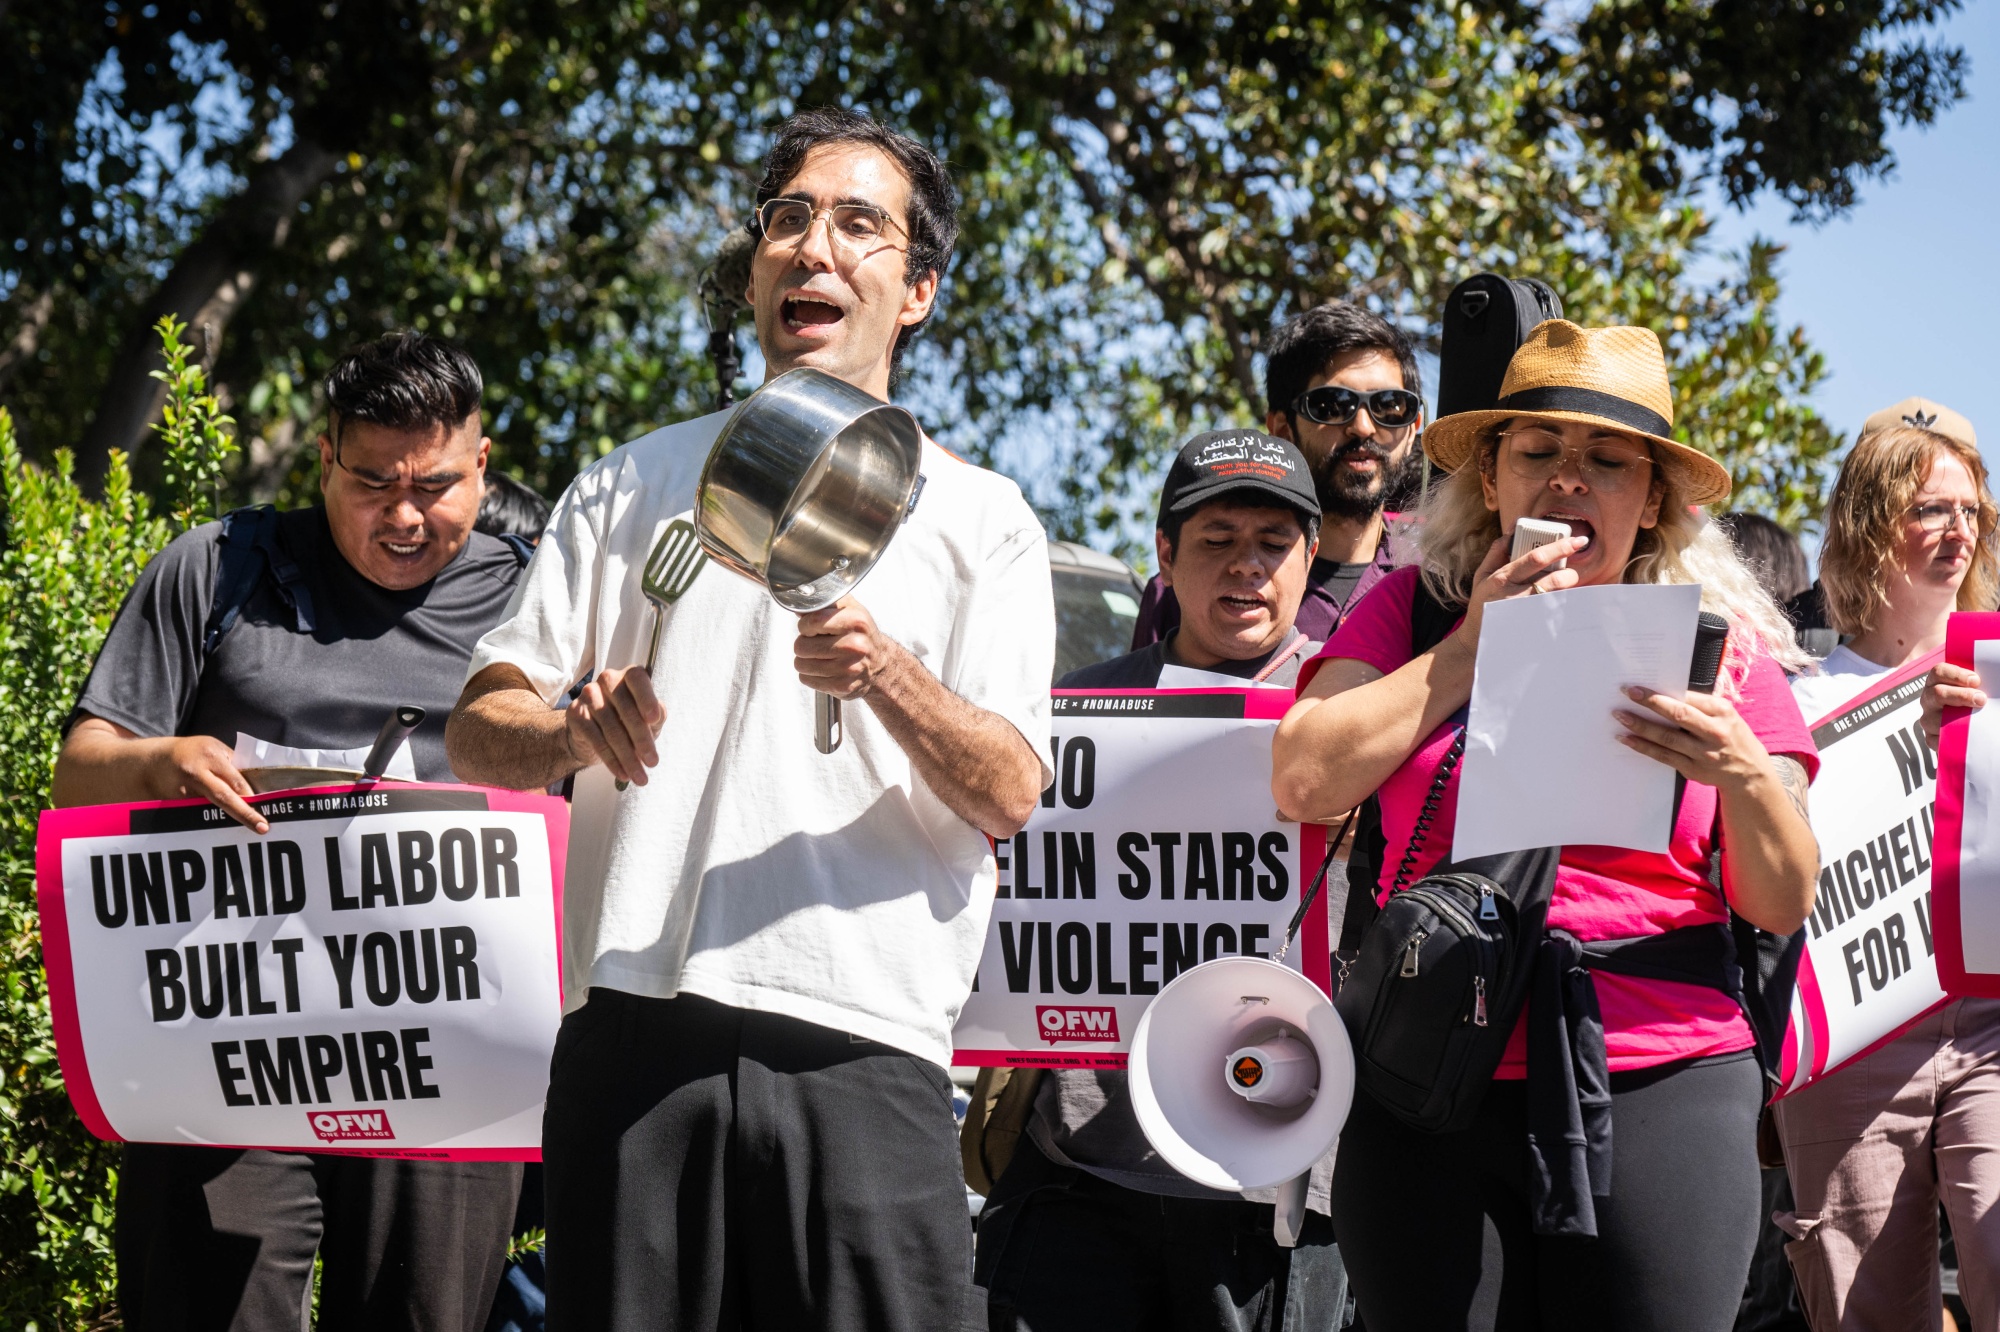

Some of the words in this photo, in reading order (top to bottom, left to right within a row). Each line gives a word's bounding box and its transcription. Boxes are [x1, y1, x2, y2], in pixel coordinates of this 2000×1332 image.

[1255, 469, 1282, 480] clothing
[1082, 698, 1155, 710] #NOMAABUSE
[1833, 716, 1852, 733] ONE
[1851, 706, 1873, 723] FAIR
[1870, 695, 1893, 713] WAGE
[203, 808, 226, 821] ONE
[260, 801, 294, 816] WAGE
[309, 794, 389, 812] #NOMAABUSE
[90, 838, 307, 929] UNPAID
[324, 827, 521, 912] LABOR
[1116, 831, 1290, 902] STARS
[144, 937, 305, 1023] BUILT
[322, 925, 482, 1010] YOUR
[1842, 912, 1912, 1007] FOR
[1041, 1009, 1111, 1031] OFW
[210, 1027, 441, 1108] EMPIRE
[313, 1113, 384, 1133] OFW
